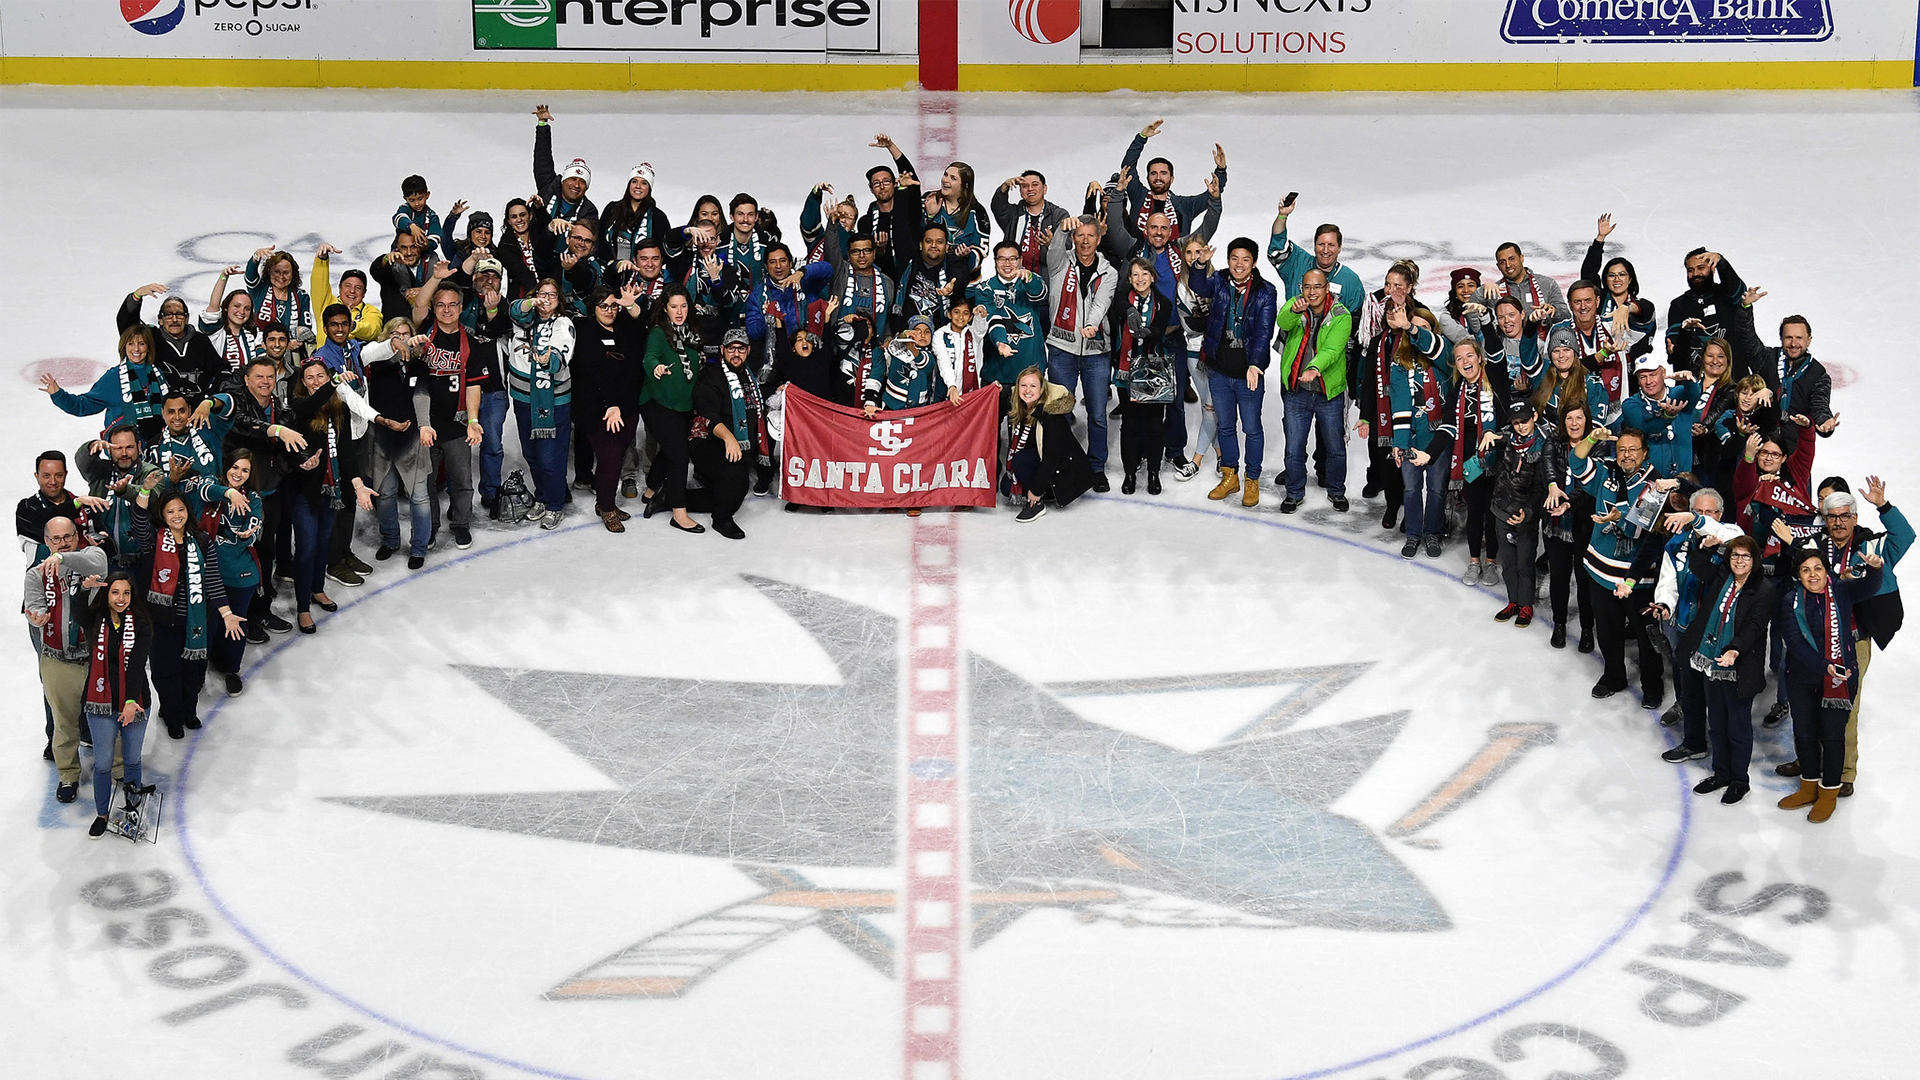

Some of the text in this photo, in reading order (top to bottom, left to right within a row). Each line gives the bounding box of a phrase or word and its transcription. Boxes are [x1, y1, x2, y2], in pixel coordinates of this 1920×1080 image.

[214, 23, 301, 32] ZERO SUGAR
[1176, 32, 1346, 54] SOLUTIONS
[449, 375, 460, 393] 3
[787, 456, 991, 494] SANTA CLARA
[80, 868, 310, 1028] Jose
[1620, 870, 1831, 1028] SAP
